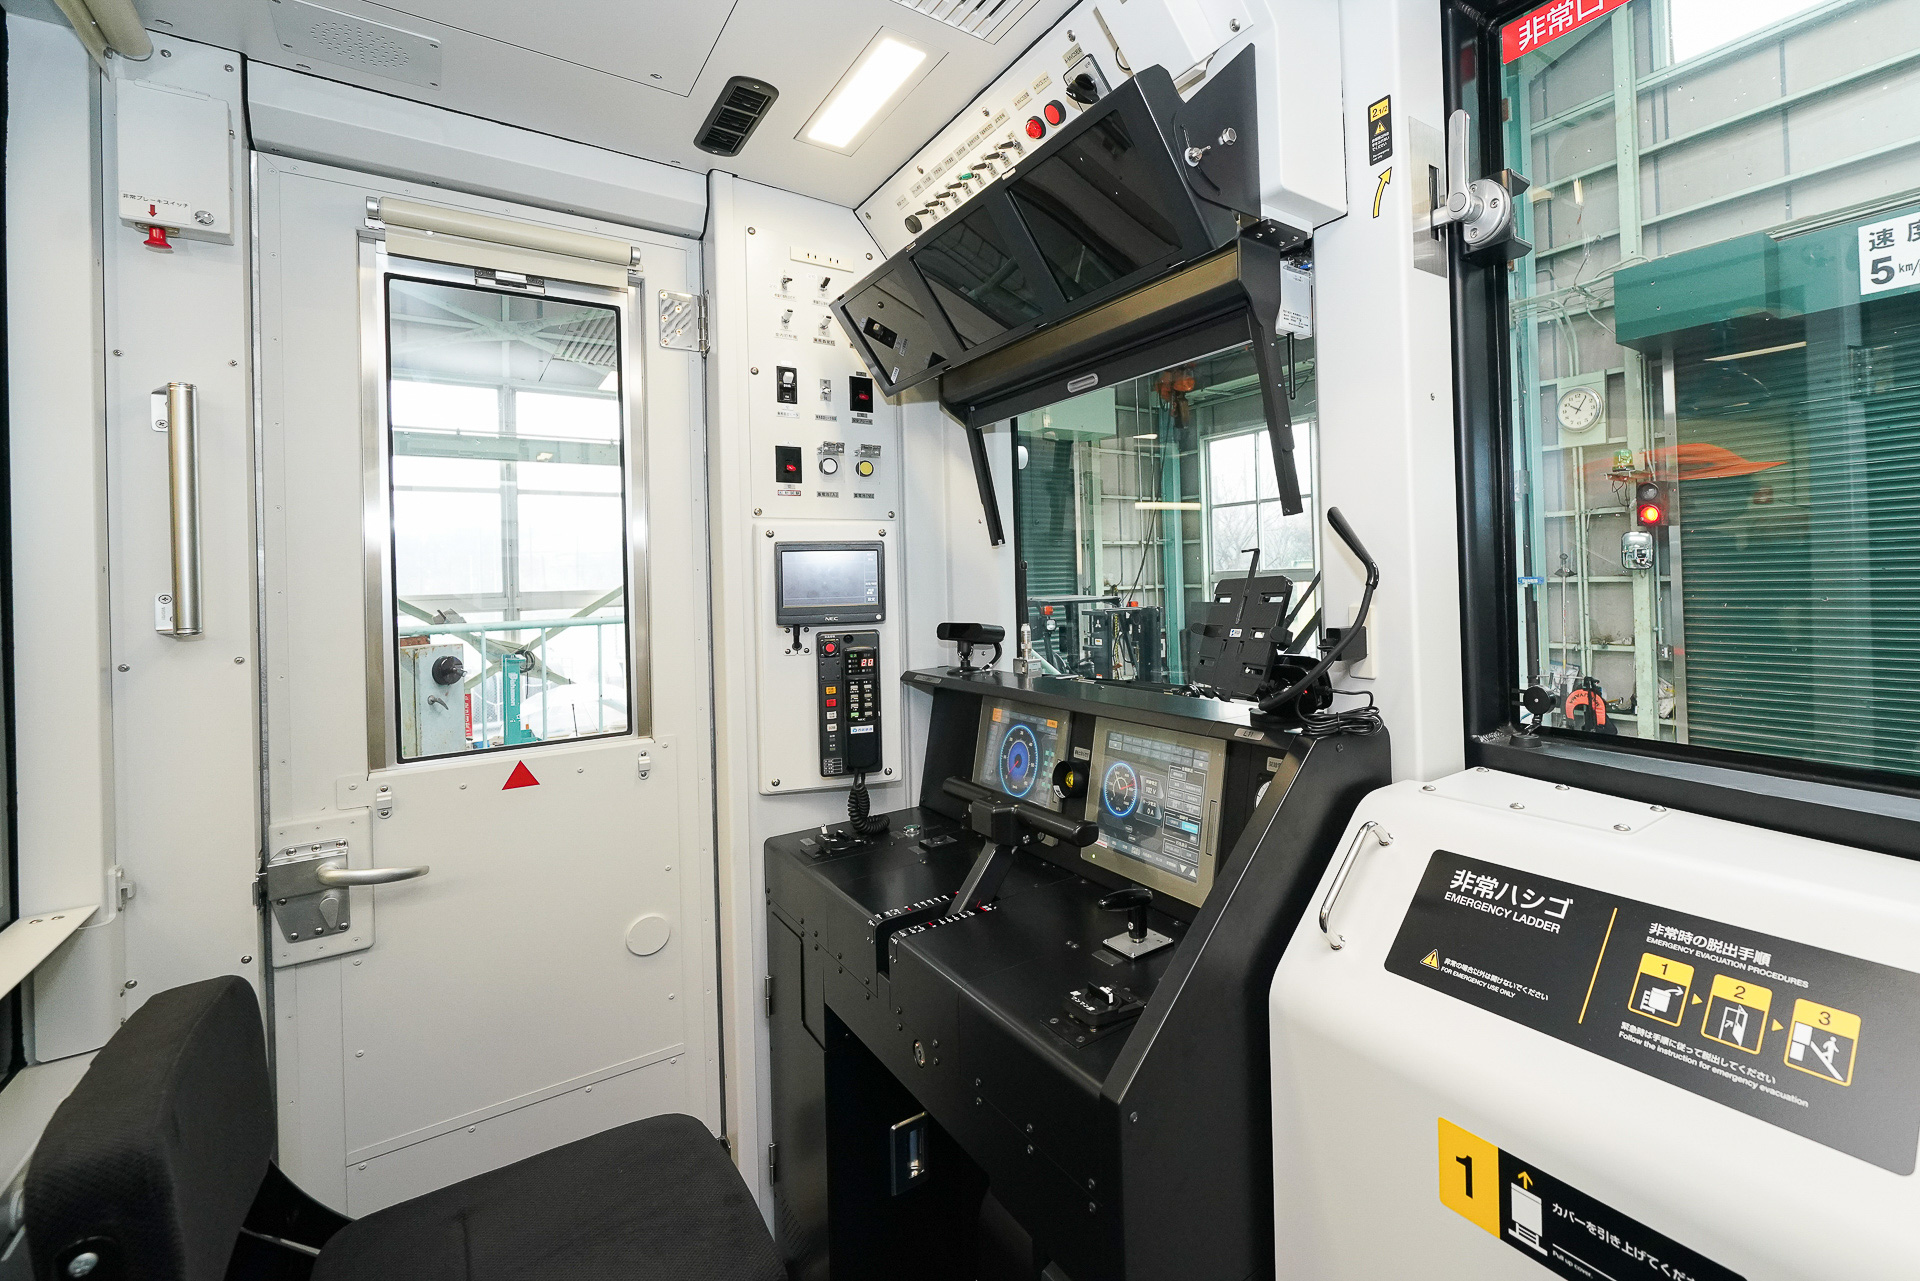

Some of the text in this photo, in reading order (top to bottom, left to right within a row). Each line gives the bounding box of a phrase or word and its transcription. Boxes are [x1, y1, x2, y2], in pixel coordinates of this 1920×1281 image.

[1444, 891, 1561, 934] EMERGENCY LADDER
[1449, 869, 1574, 919] 非常ハシゴ
[1646, 936, 1809, 989] EMERGENCY EVACUATION PROCEDURES
[1648, 922, 1772, 967] 非常時の脱出手順
[1440, 966, 1516, 998] FOR EMERGENCY USE ONLY
[1661, 963, 1669, 975] 1
[1734, 986, 1746, 999] 2
[1818, 1011, 1831, 1026] 3
[1618, 1031, 1809, 1108] Follow the instruction for emergency evacuation
[1620, 1021, 1776, 1085] 緊急時は手順に従って脱出してください
[1455, 1154, 1473, 1200] 1
[1552, 1202, 1697, 1281] カバーを引き上げてくだ
[1552, 1250, 1564, 1262] Pull
[1565, 1258, 1574, 1268] up
